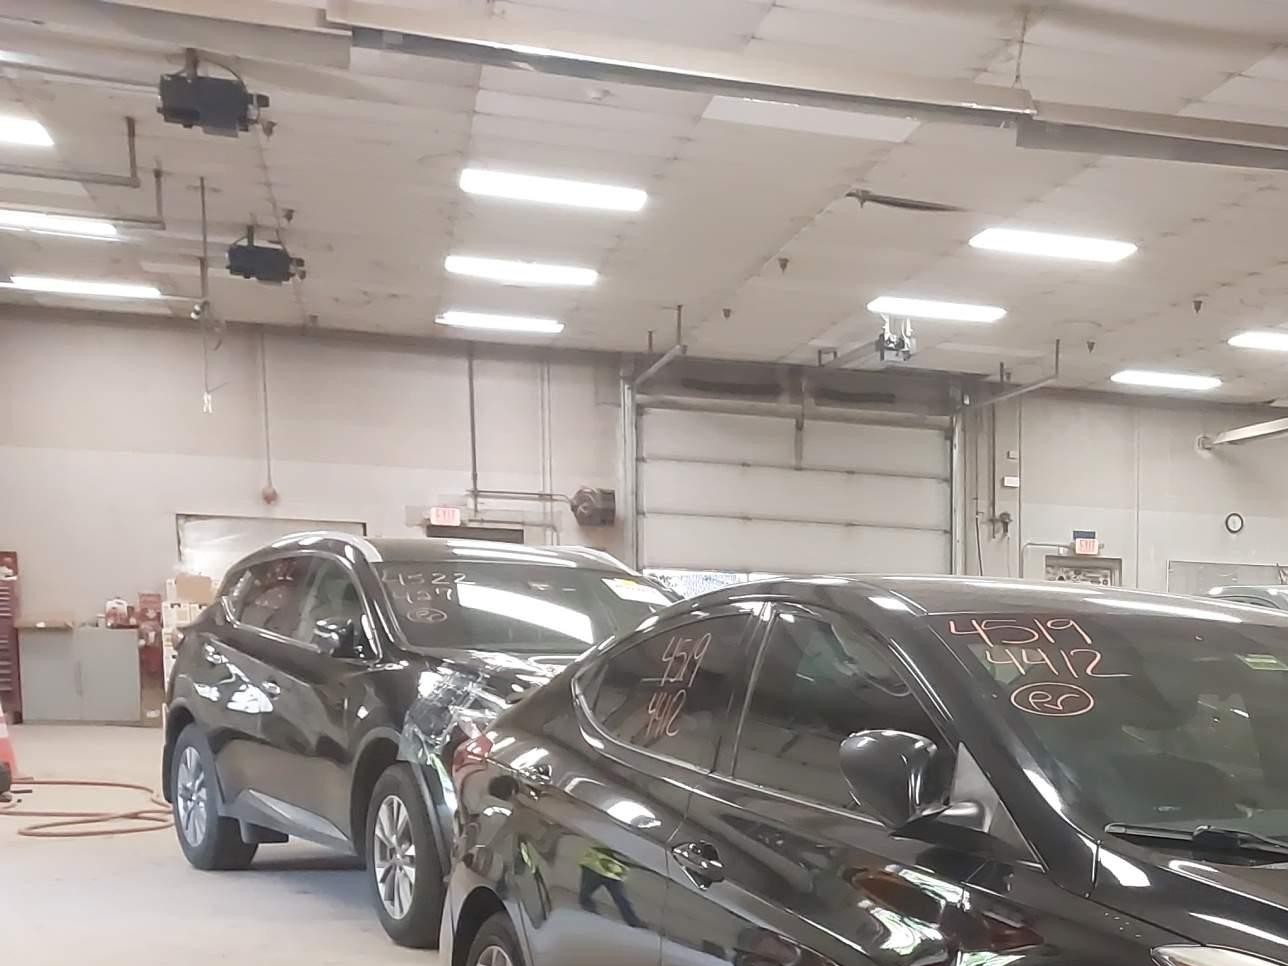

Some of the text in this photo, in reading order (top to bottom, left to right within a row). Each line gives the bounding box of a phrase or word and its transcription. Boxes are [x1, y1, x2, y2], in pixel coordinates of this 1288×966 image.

[382, 570, 476, 586] 4522
[950, 618, 1092, 647] 4519
[642, 632, 711, 688] 4519
[986, 648, 1133, 678] 4412
